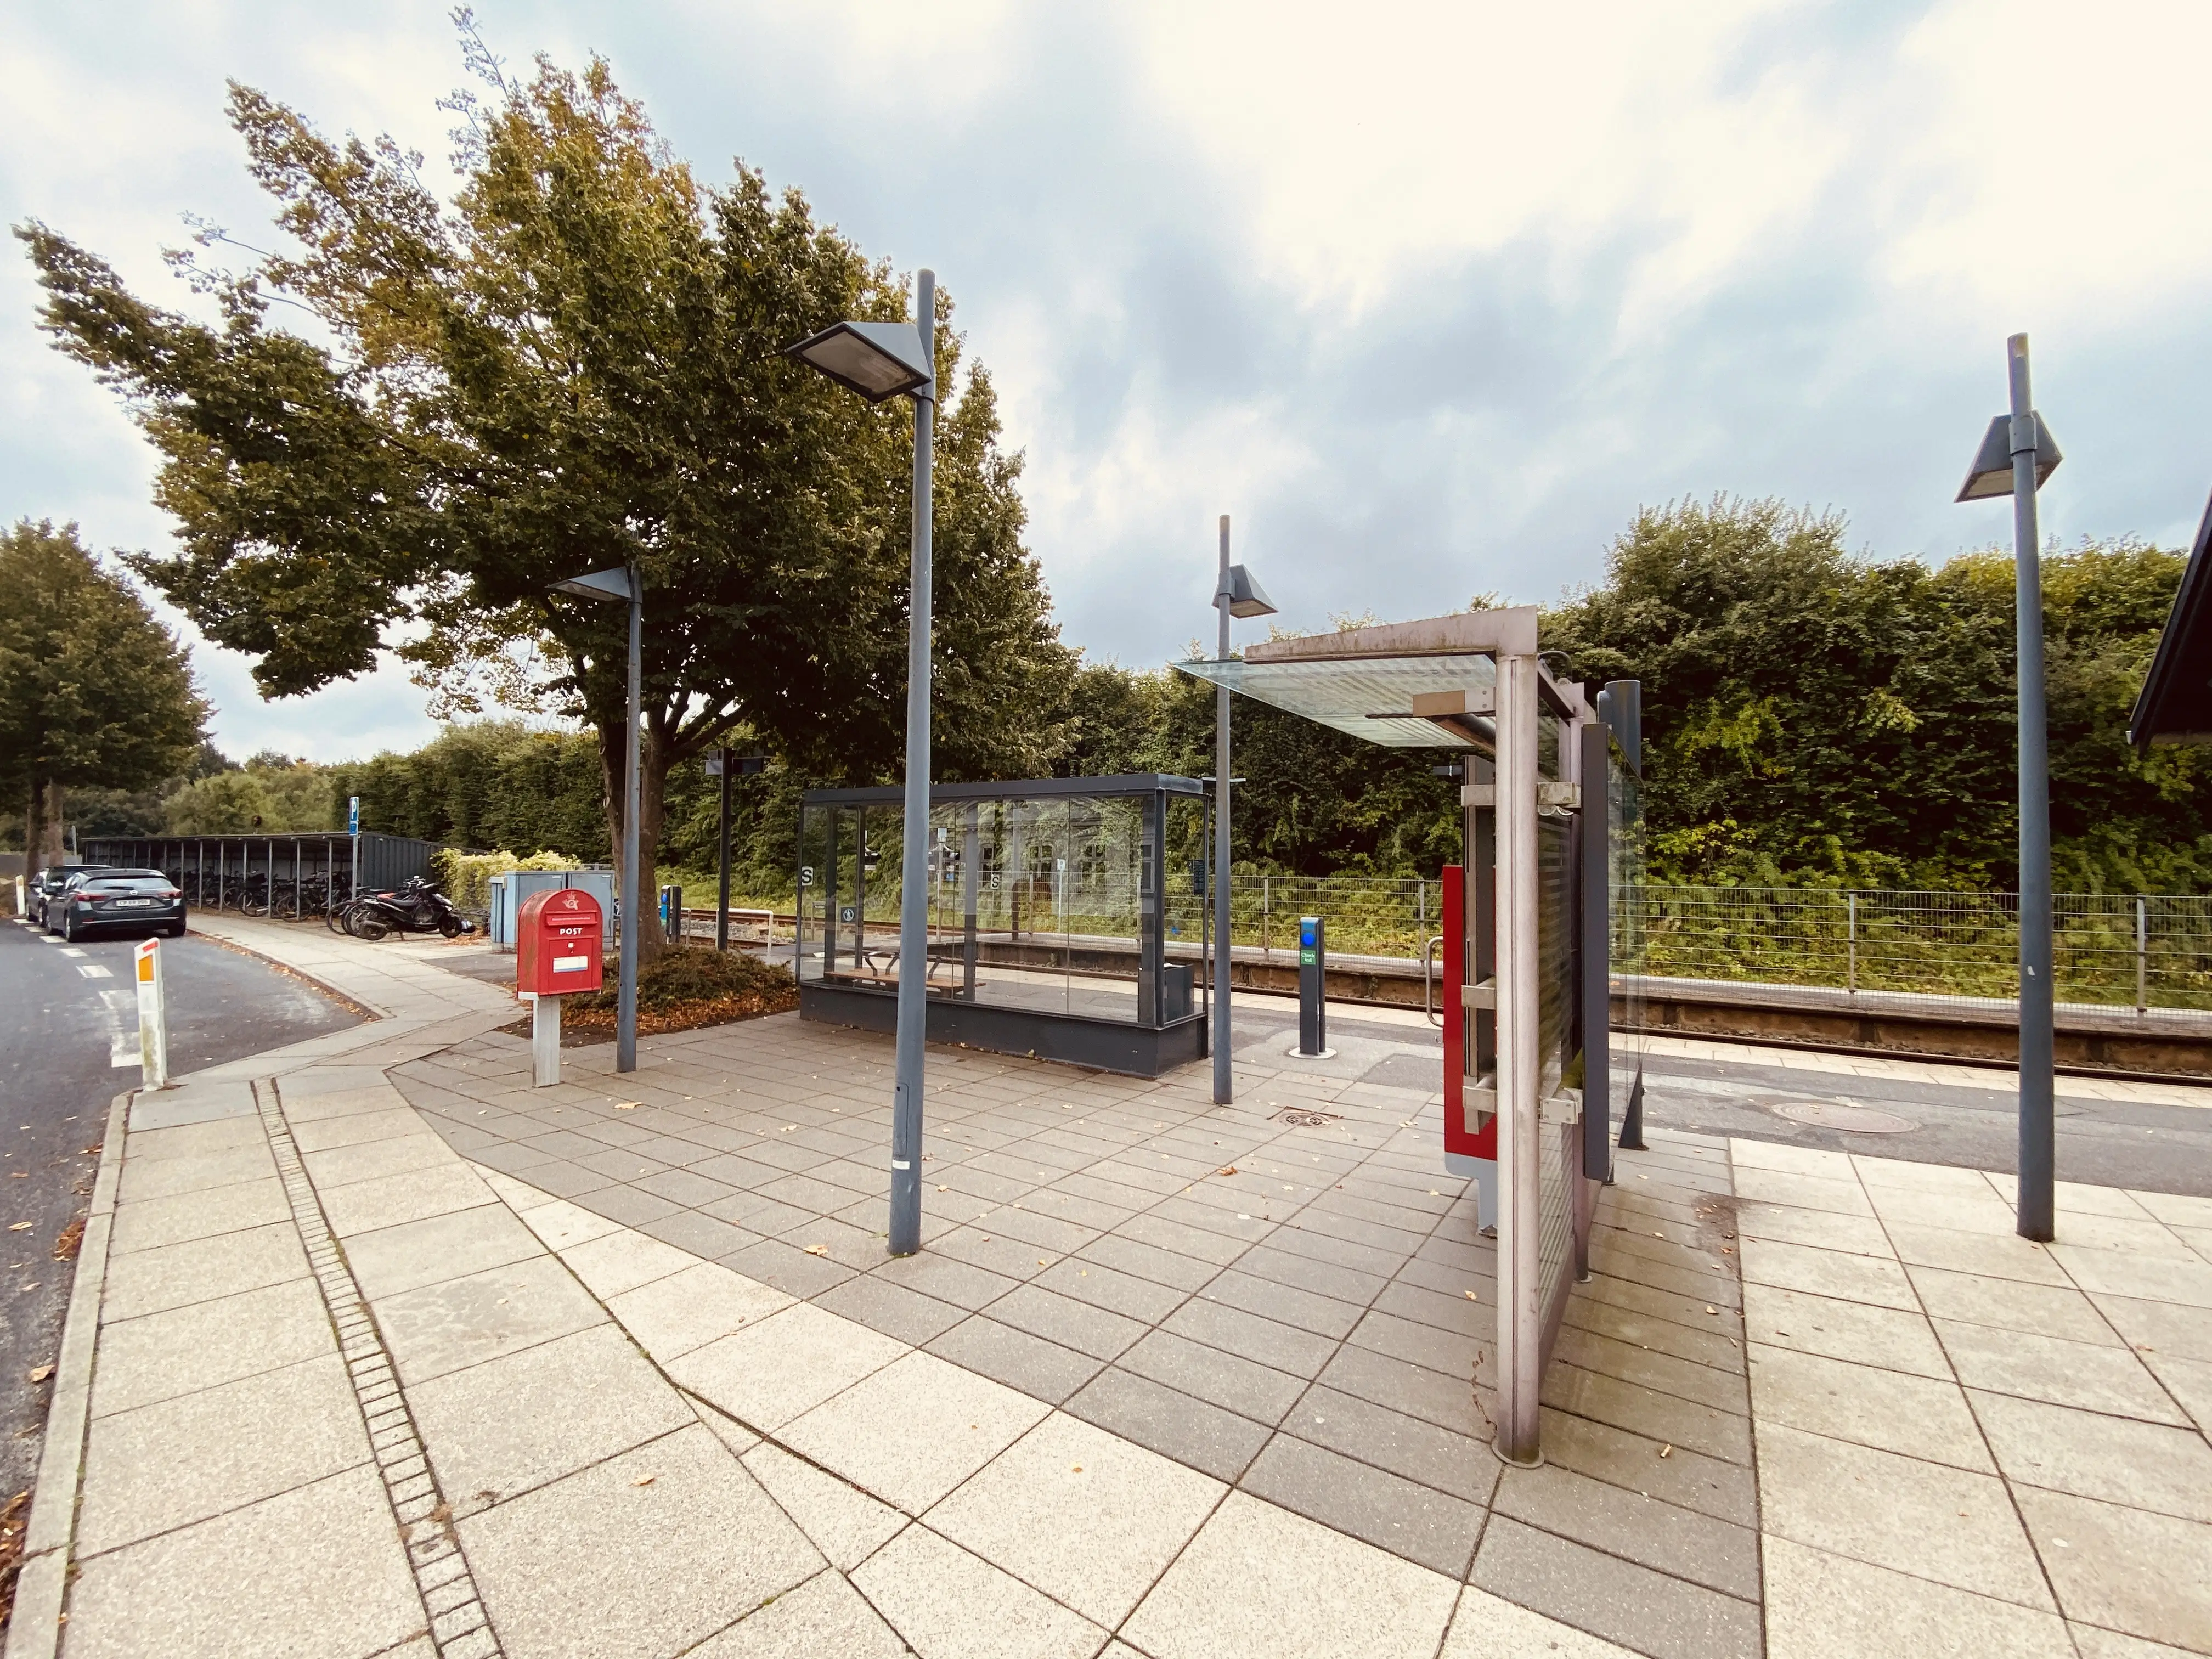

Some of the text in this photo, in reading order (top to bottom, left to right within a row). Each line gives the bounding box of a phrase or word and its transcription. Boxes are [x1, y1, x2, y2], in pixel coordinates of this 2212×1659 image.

[352, 800, 357, 819] P
[802, 869, 812, 883] S
[992, 876, 998, 888] S
